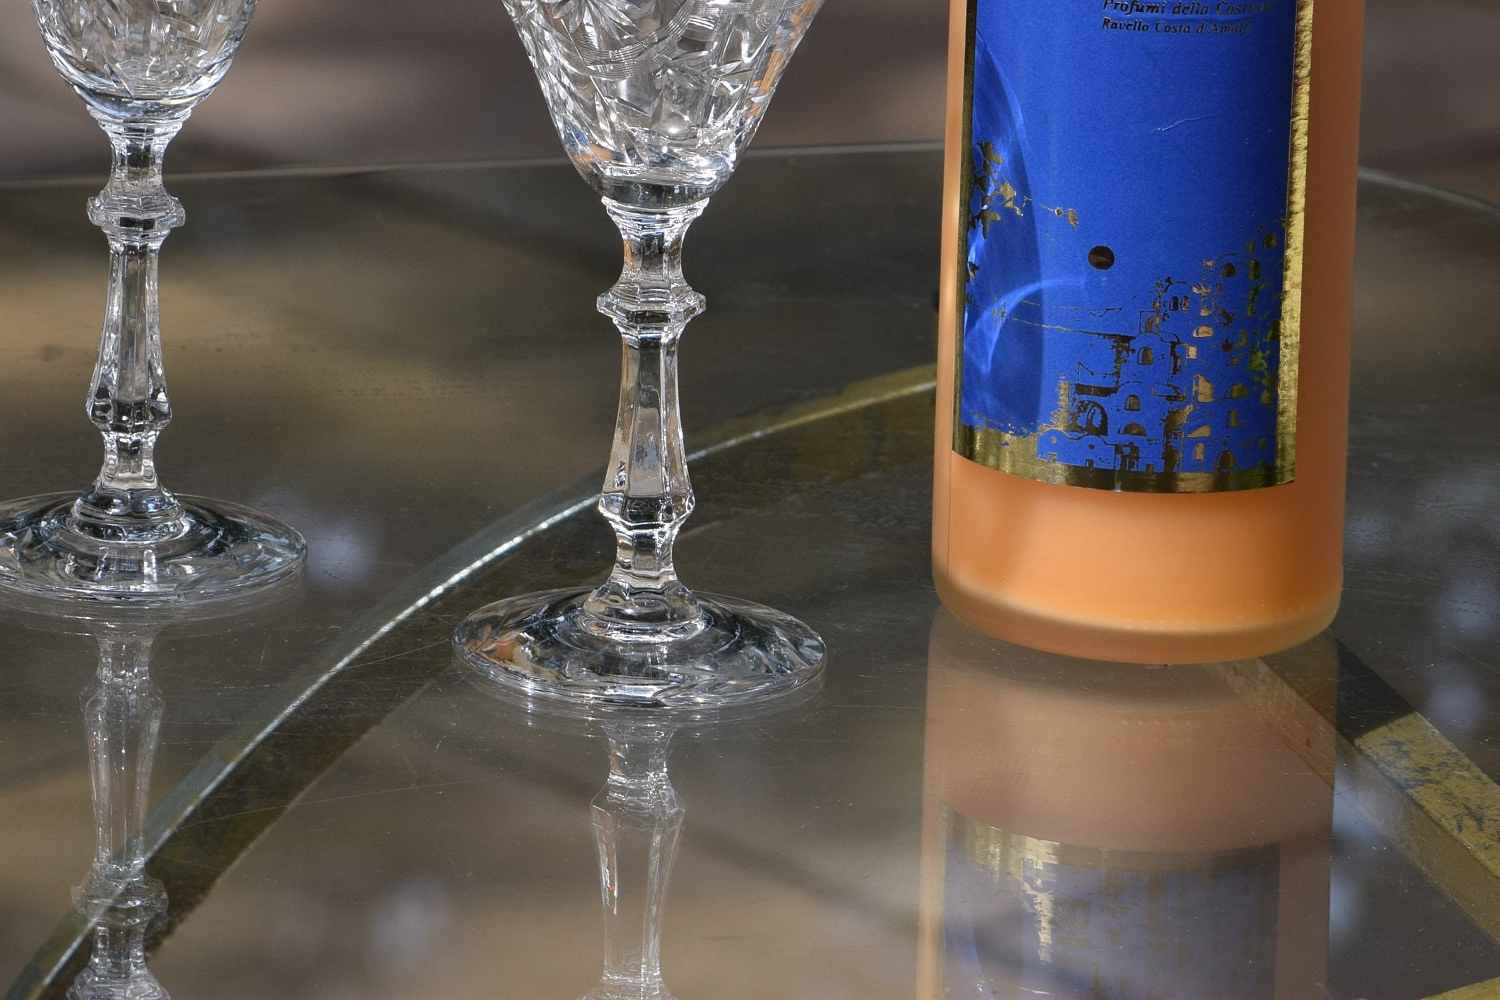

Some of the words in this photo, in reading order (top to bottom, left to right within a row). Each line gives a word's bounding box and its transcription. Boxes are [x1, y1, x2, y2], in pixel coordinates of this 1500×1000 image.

[1172, 1, 1208, 16] della
[1102, 17, 1150, 32] Ravello
[1155, 21, 1191, 34] Costa
